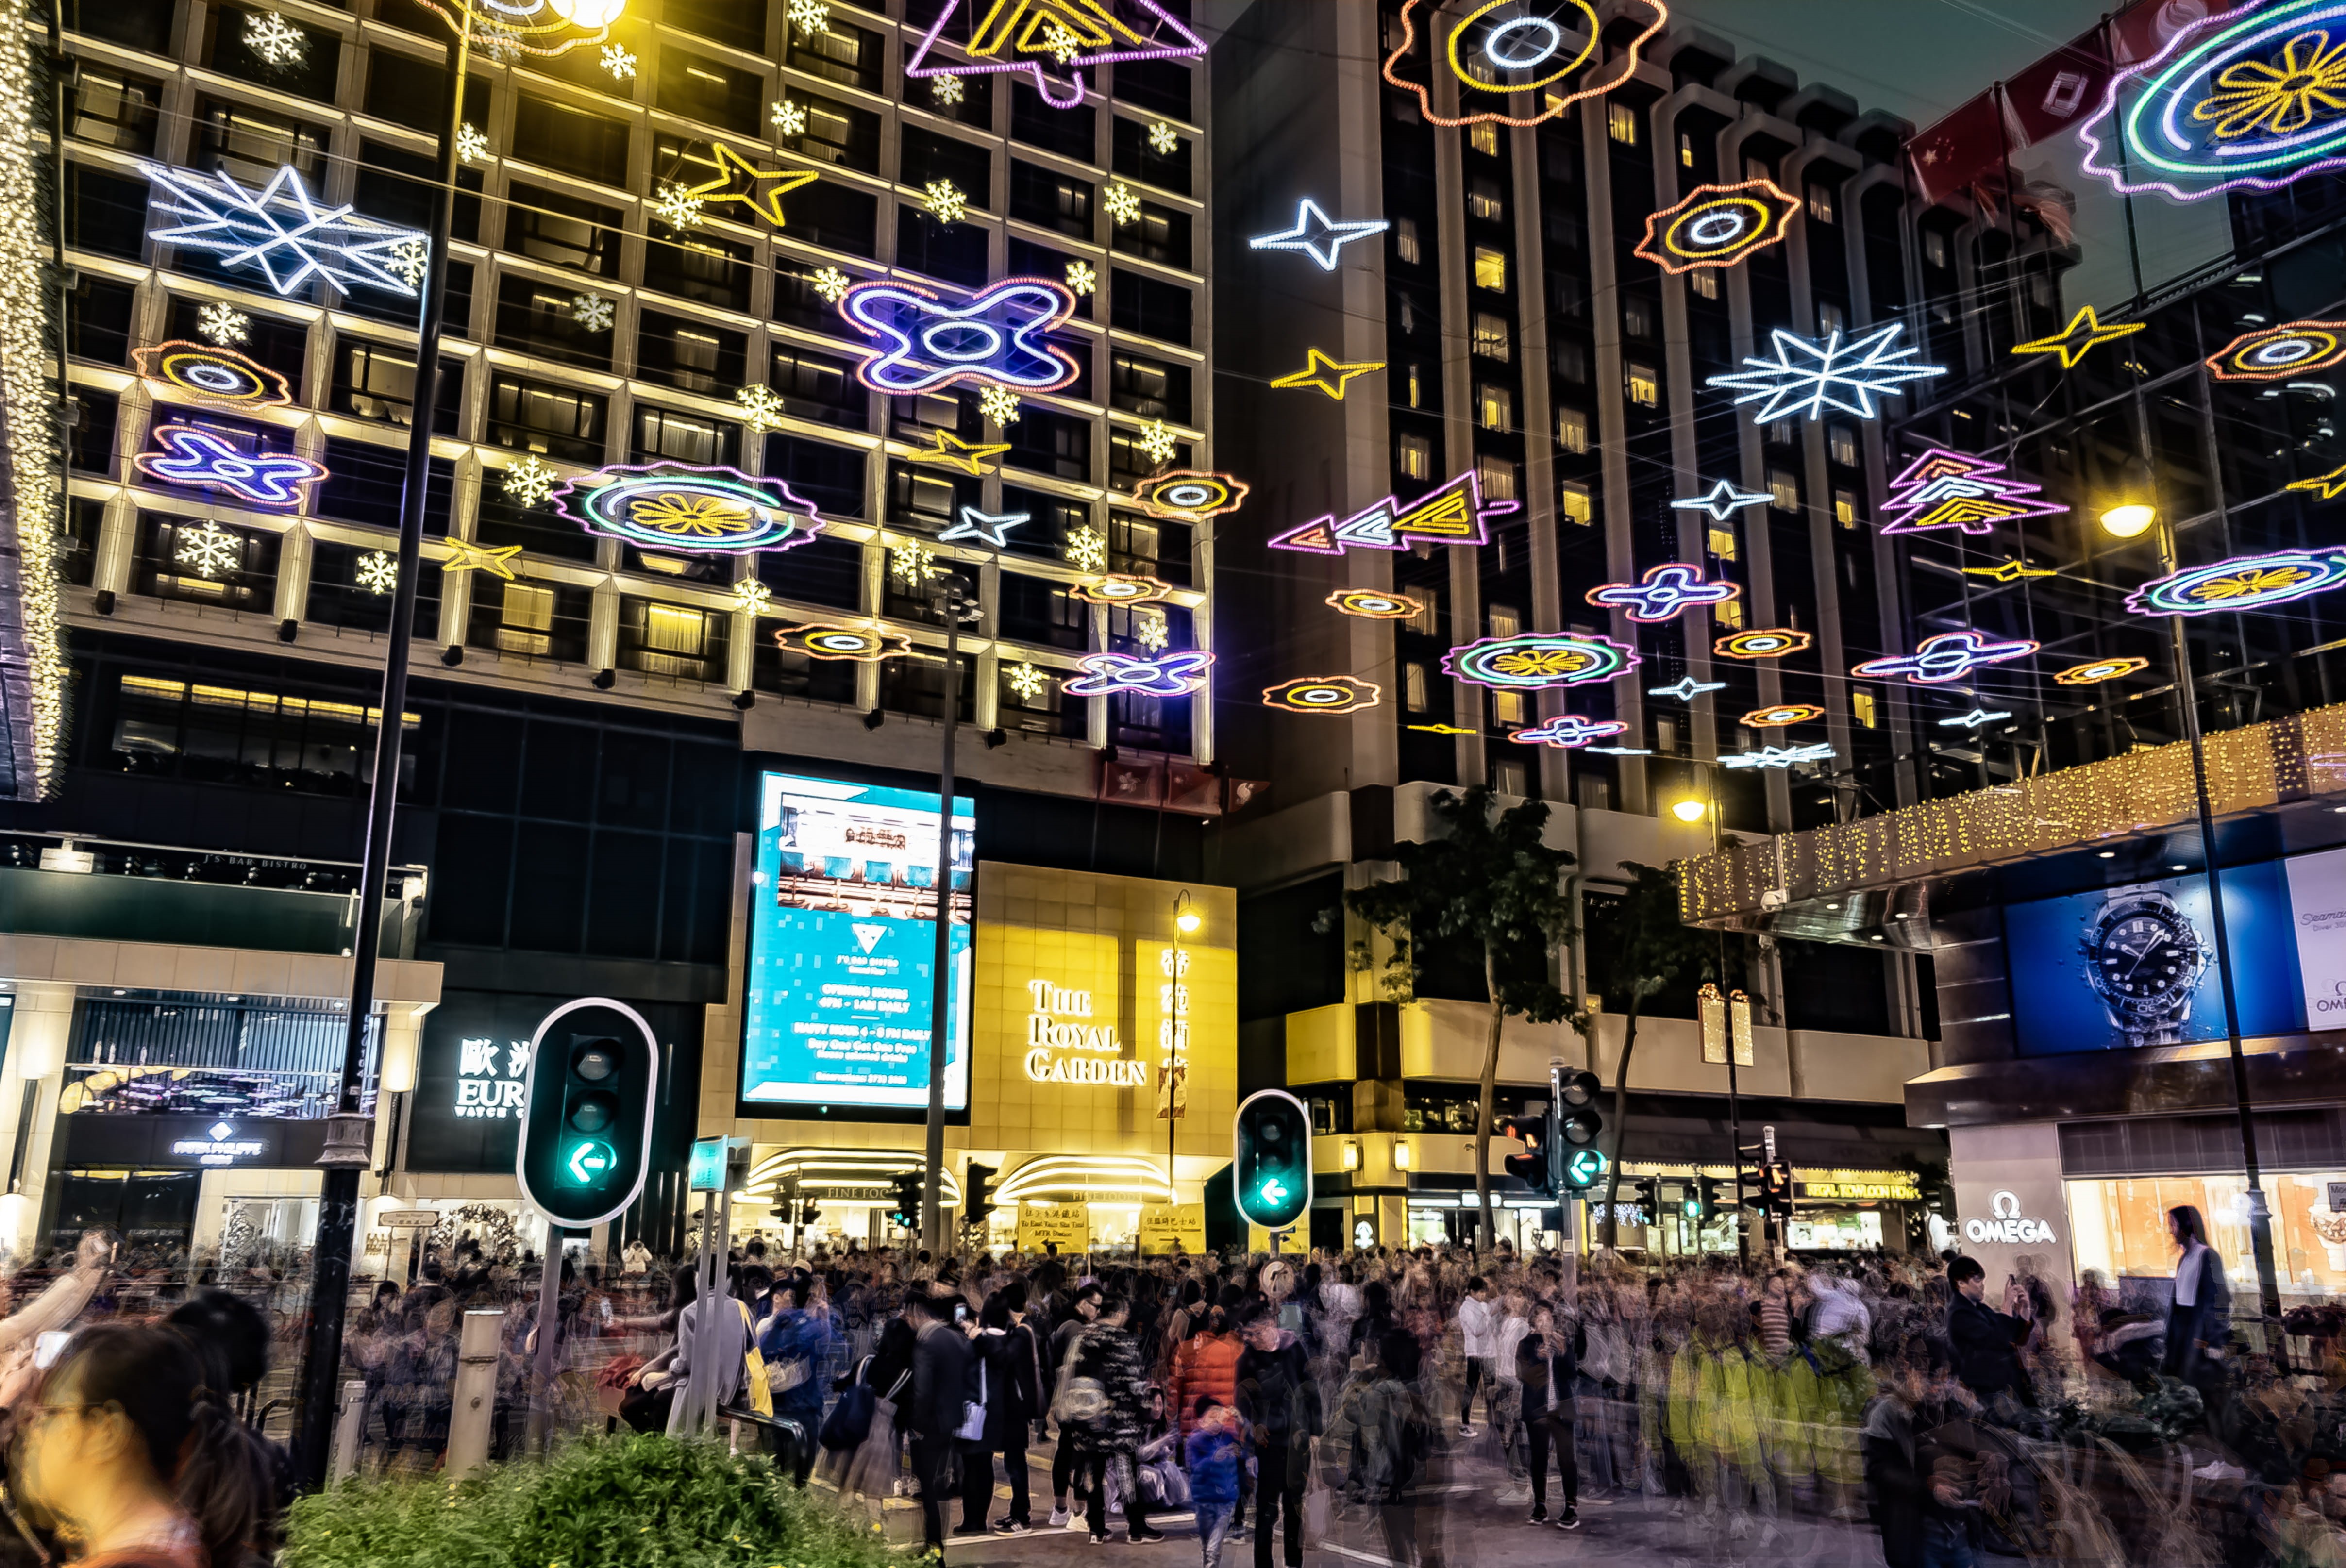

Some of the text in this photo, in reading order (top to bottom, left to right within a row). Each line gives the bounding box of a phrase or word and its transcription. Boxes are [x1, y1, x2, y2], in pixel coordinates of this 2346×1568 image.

[229, 857, 253, 866] BAR
[262, 859, 307, 870] BISTRO
[872, 987, 908, 1000] HOURS
[1160, 948, 1190, 1068] 帝苑酒
[456, 1079, 525, 1108] EUR
[454, 1106, 507, 1118] WATCH
[1806, 1183, 1838, 1197] REGAL
[1839, 1184, 1890, 1199] KOWLOON
[1966, 1218, 2057, 1243] OMEGA
